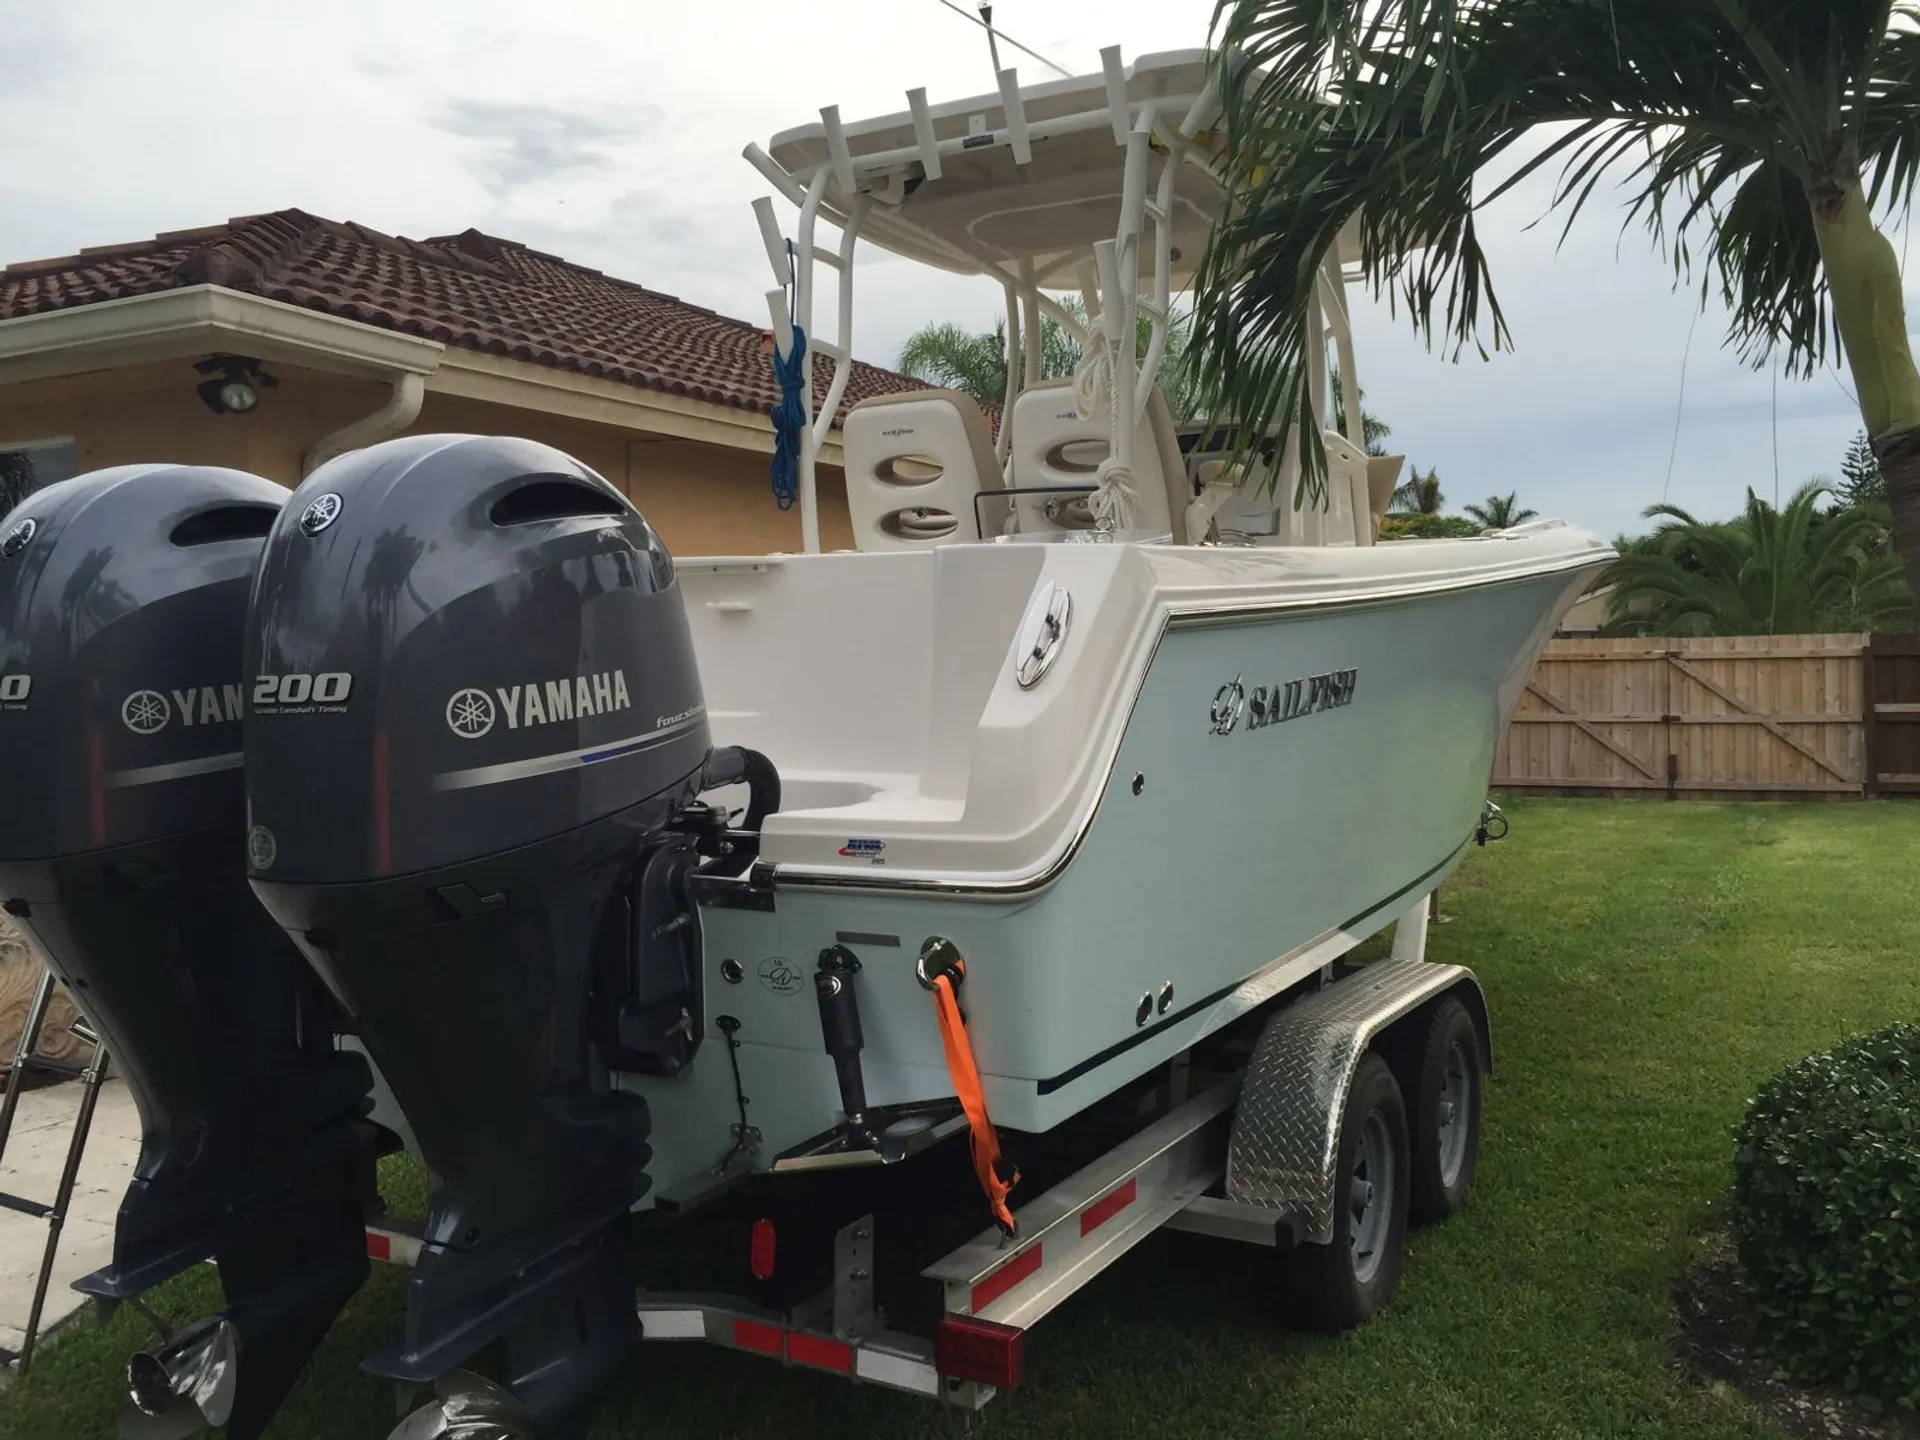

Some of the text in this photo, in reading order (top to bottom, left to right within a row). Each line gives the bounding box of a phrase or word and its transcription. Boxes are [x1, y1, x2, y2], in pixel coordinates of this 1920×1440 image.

[253, 672, 352, 704] 200
[496, 669, 632, 730] YAMAHA
[1245, 666, 1359, 731] SAILFISH
